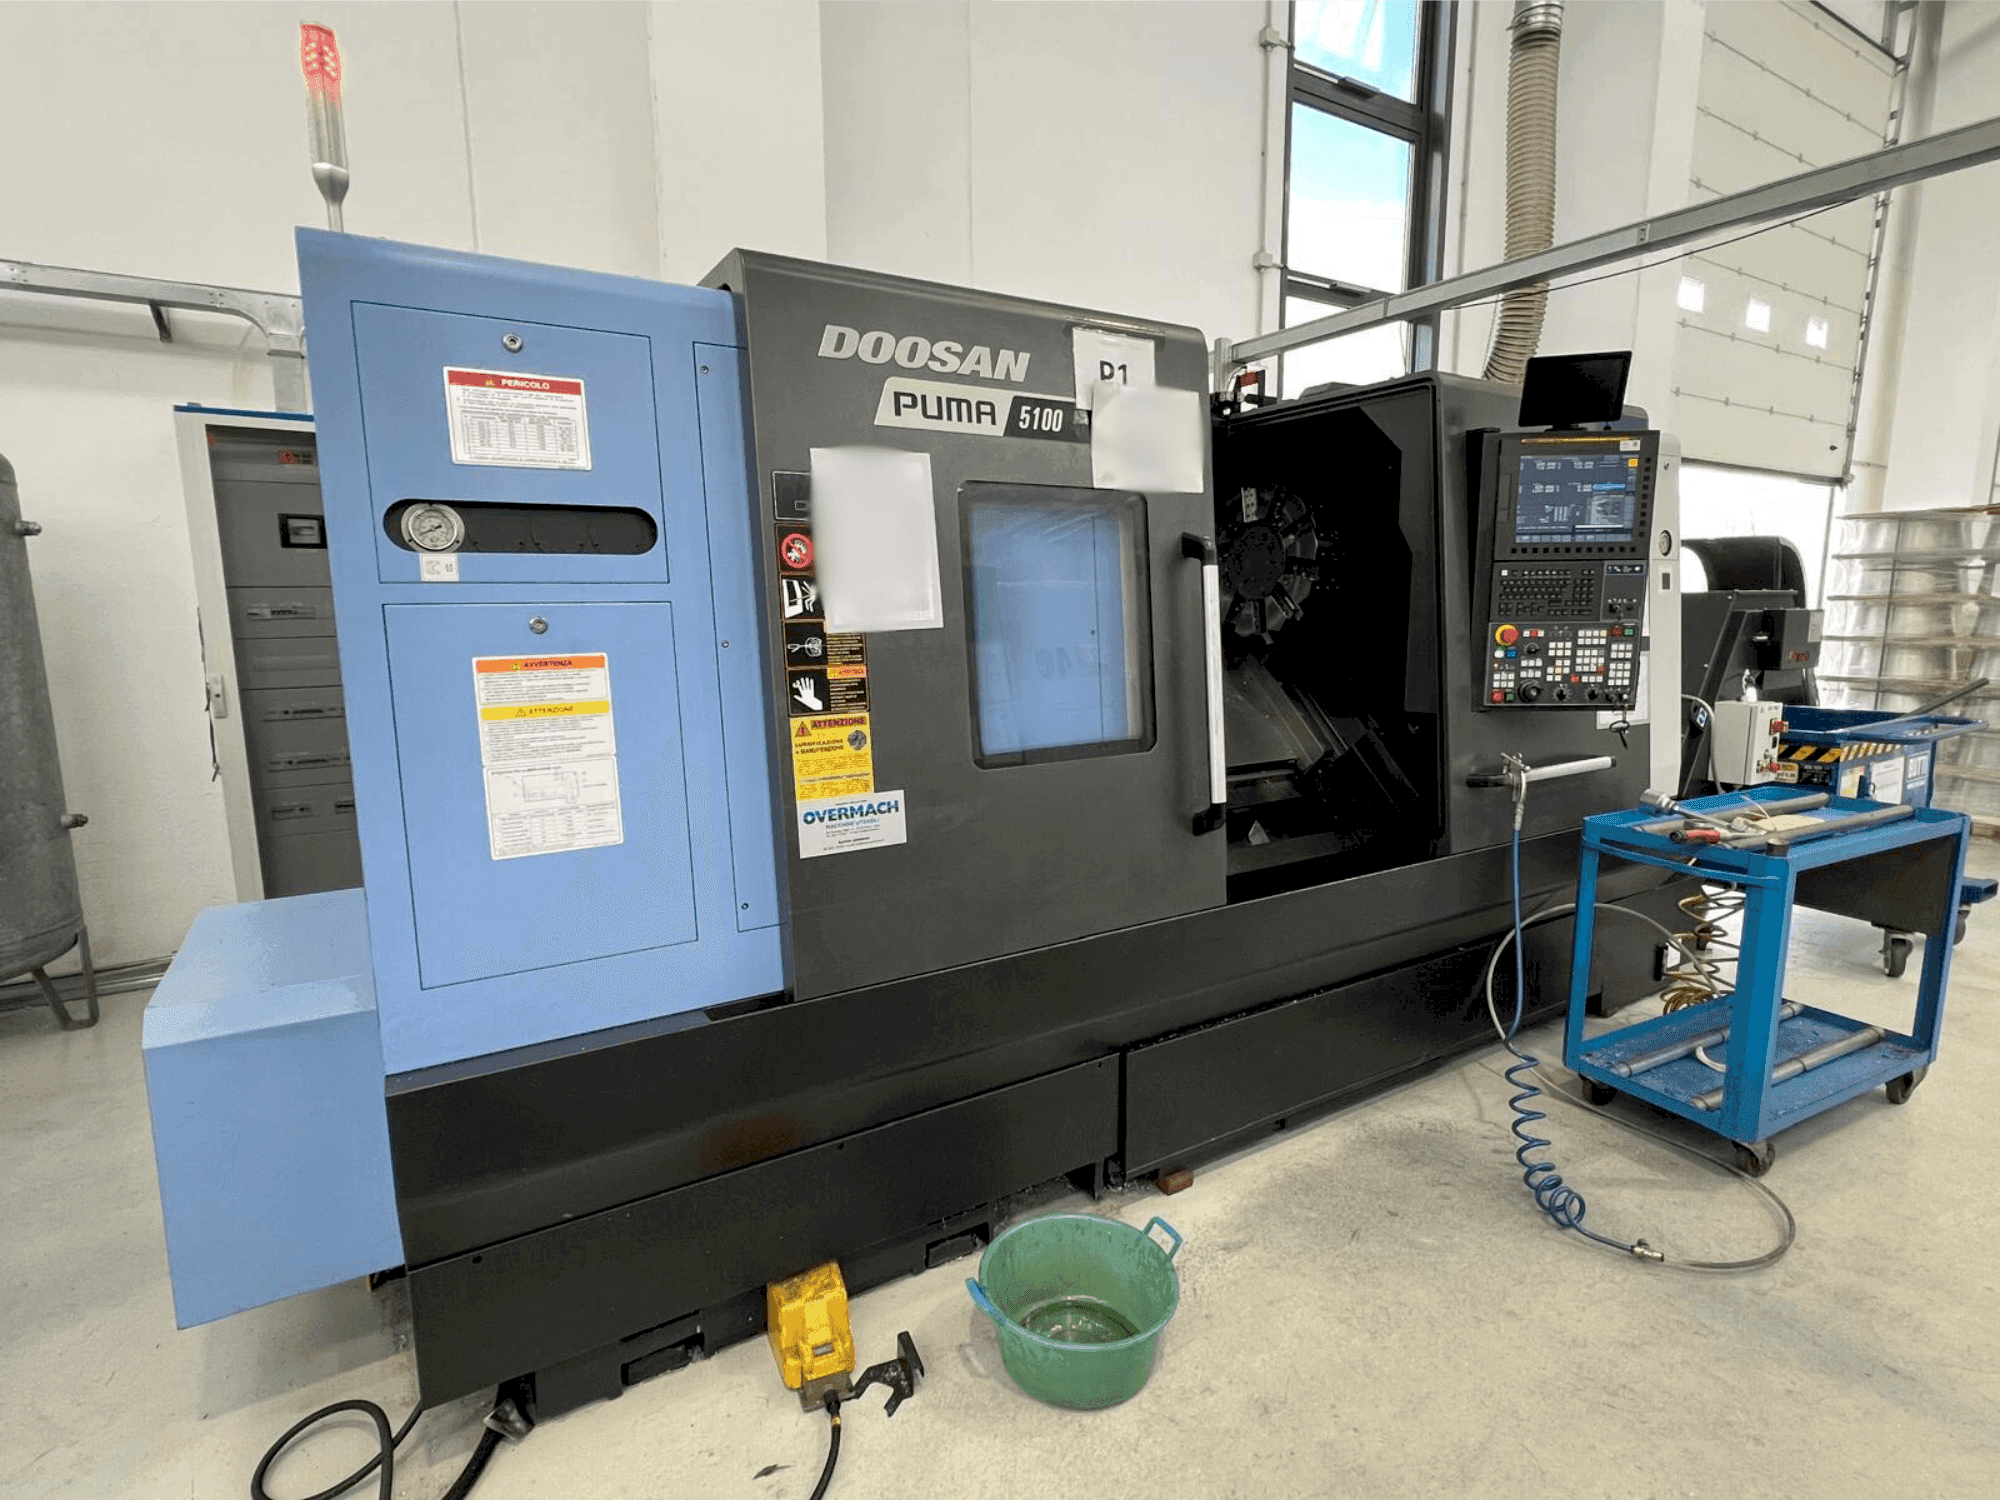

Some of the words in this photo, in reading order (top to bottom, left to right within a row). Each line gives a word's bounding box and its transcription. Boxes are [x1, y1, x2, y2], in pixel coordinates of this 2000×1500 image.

[818, 324, 1030, 382] DOOSAN
[501, 379, 550, 390] PERICOLO
[892, 391, 997, 426] PUMA
[1019, 408, 1064, 433] 5100
[524, 660, 572, 668] AVVERTENZA
[528, 705, 574, 715] ATTENZIONE
[813, 717, 865, 728] ATTENZIONE
[802, 800, 900, 825] OVERMACH
